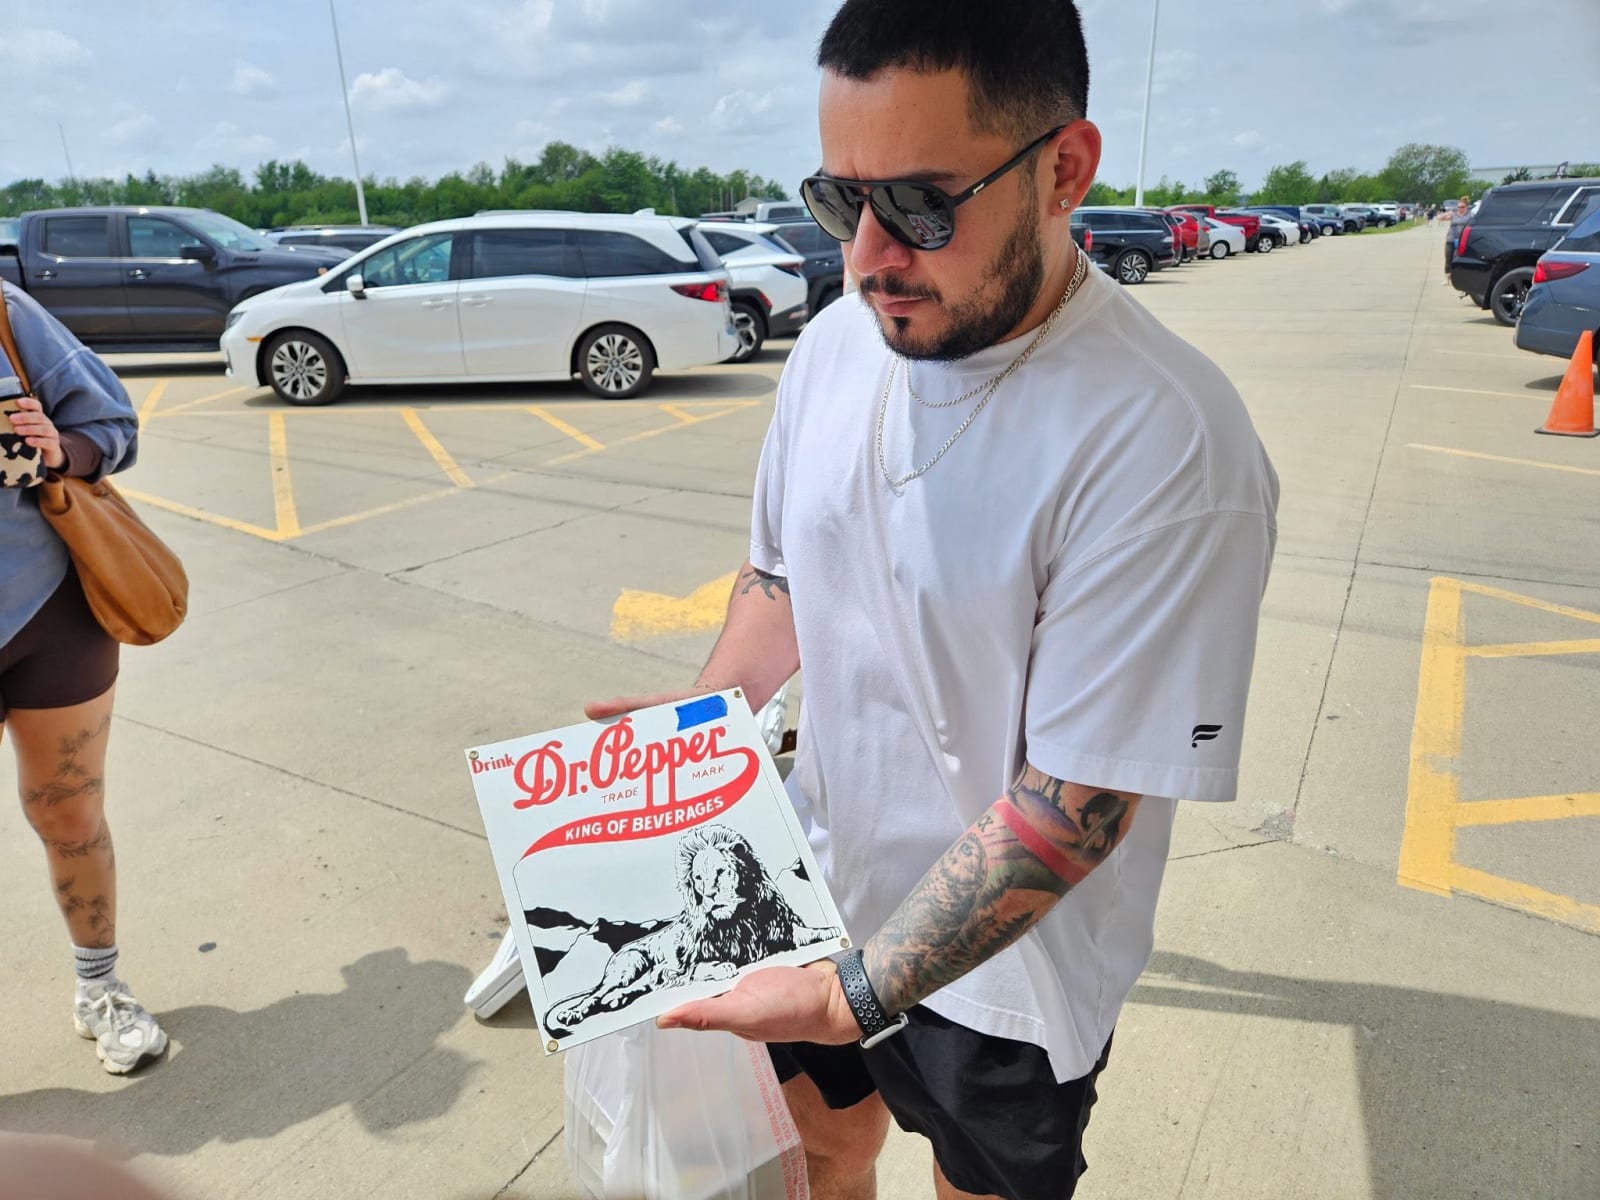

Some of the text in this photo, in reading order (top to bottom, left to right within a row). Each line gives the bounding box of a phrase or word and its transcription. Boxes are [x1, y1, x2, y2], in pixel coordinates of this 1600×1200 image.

[471, 716, 727, 810] Drink Dr. Pepper
[602, 764, 726, 804] TRADE MARK
[565, 795, 725, 841] KING OF BEVERAGES
